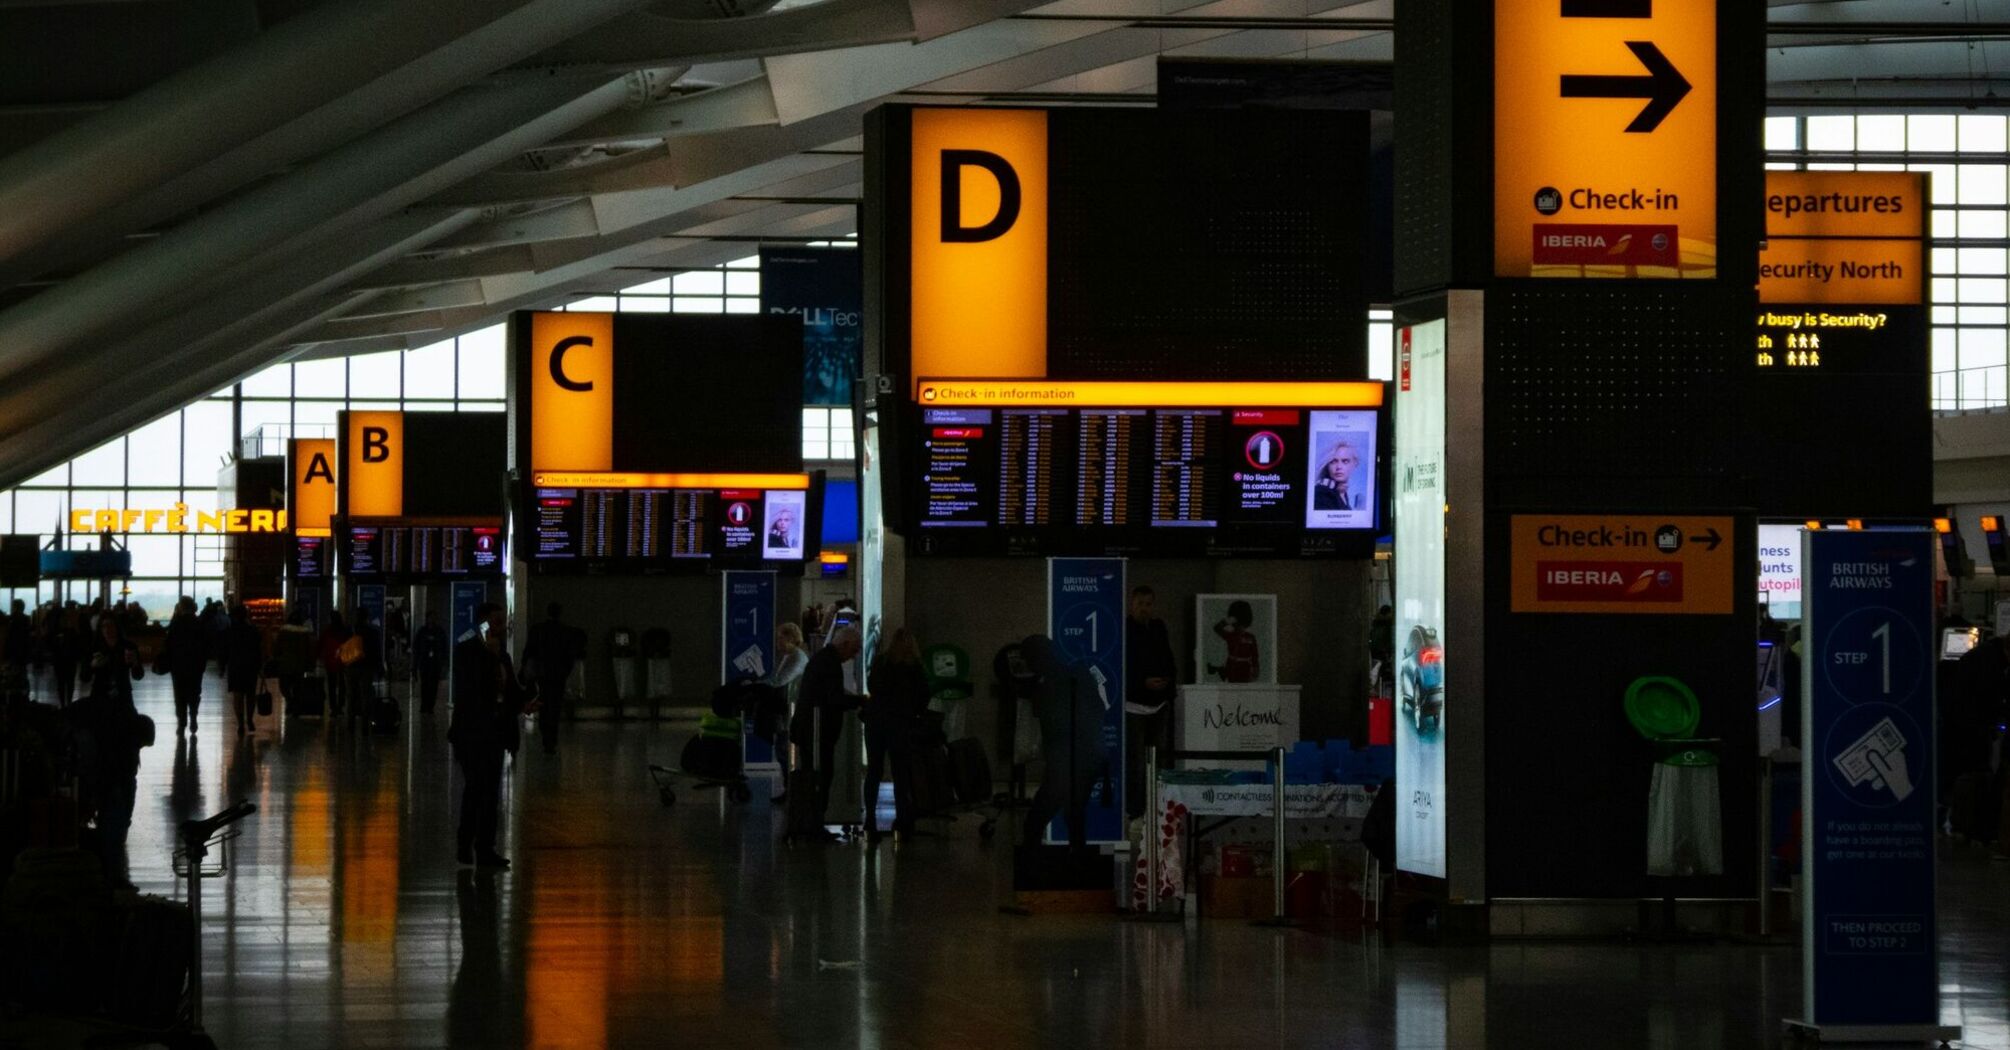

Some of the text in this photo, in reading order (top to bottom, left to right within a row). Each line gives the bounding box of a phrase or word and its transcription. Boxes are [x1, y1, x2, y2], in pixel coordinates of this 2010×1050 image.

[939, 148, 1022, 243] D
[1569, 188, 1679, 210] Check-in
[1767, 191, 1903, 219] epartures
[1542, 235, 1606, 248] IBERIA
[1760, 259, 1903, 283] ecurity North
[1767, 312, 1803, 330] busy
[1805, 312, 1818, 326] is
[1819, 312, 1888, 330] Security?
[549, 335, 593, 392] C
[999, 387, 1076, 400] information
[362, 426, 391, 463] B
[303, 452, 335, 484] A
[1242, 473, 1281, 483] No liquids
[1251, 482, 1291, 491] containers
[1241, 491, 1284, 499] over 100ml
[1537, 523, 1648, 548] Check-in
[1760, 547, 1791, 557] ness
[1758, 563, 1794, 574] unts
[1832, 562, 1890, 576] BRITISH
[1546, 570, 1625, 586] IBERIA
[1757, 579, 1802, 592] utopil
[1829, 576, 1894, 590] AIRWAYS
[1085, 610, 1098, 653] 1
[1834, 619, 1892, 695] STEP 1
[1203, 703, 1284, 729] Welcome
[1831, 921, 1921, 934] THEN PROCEED
[1848, 936, 1868, 949] TO
[1868, 936, 1898, 949] STEP
